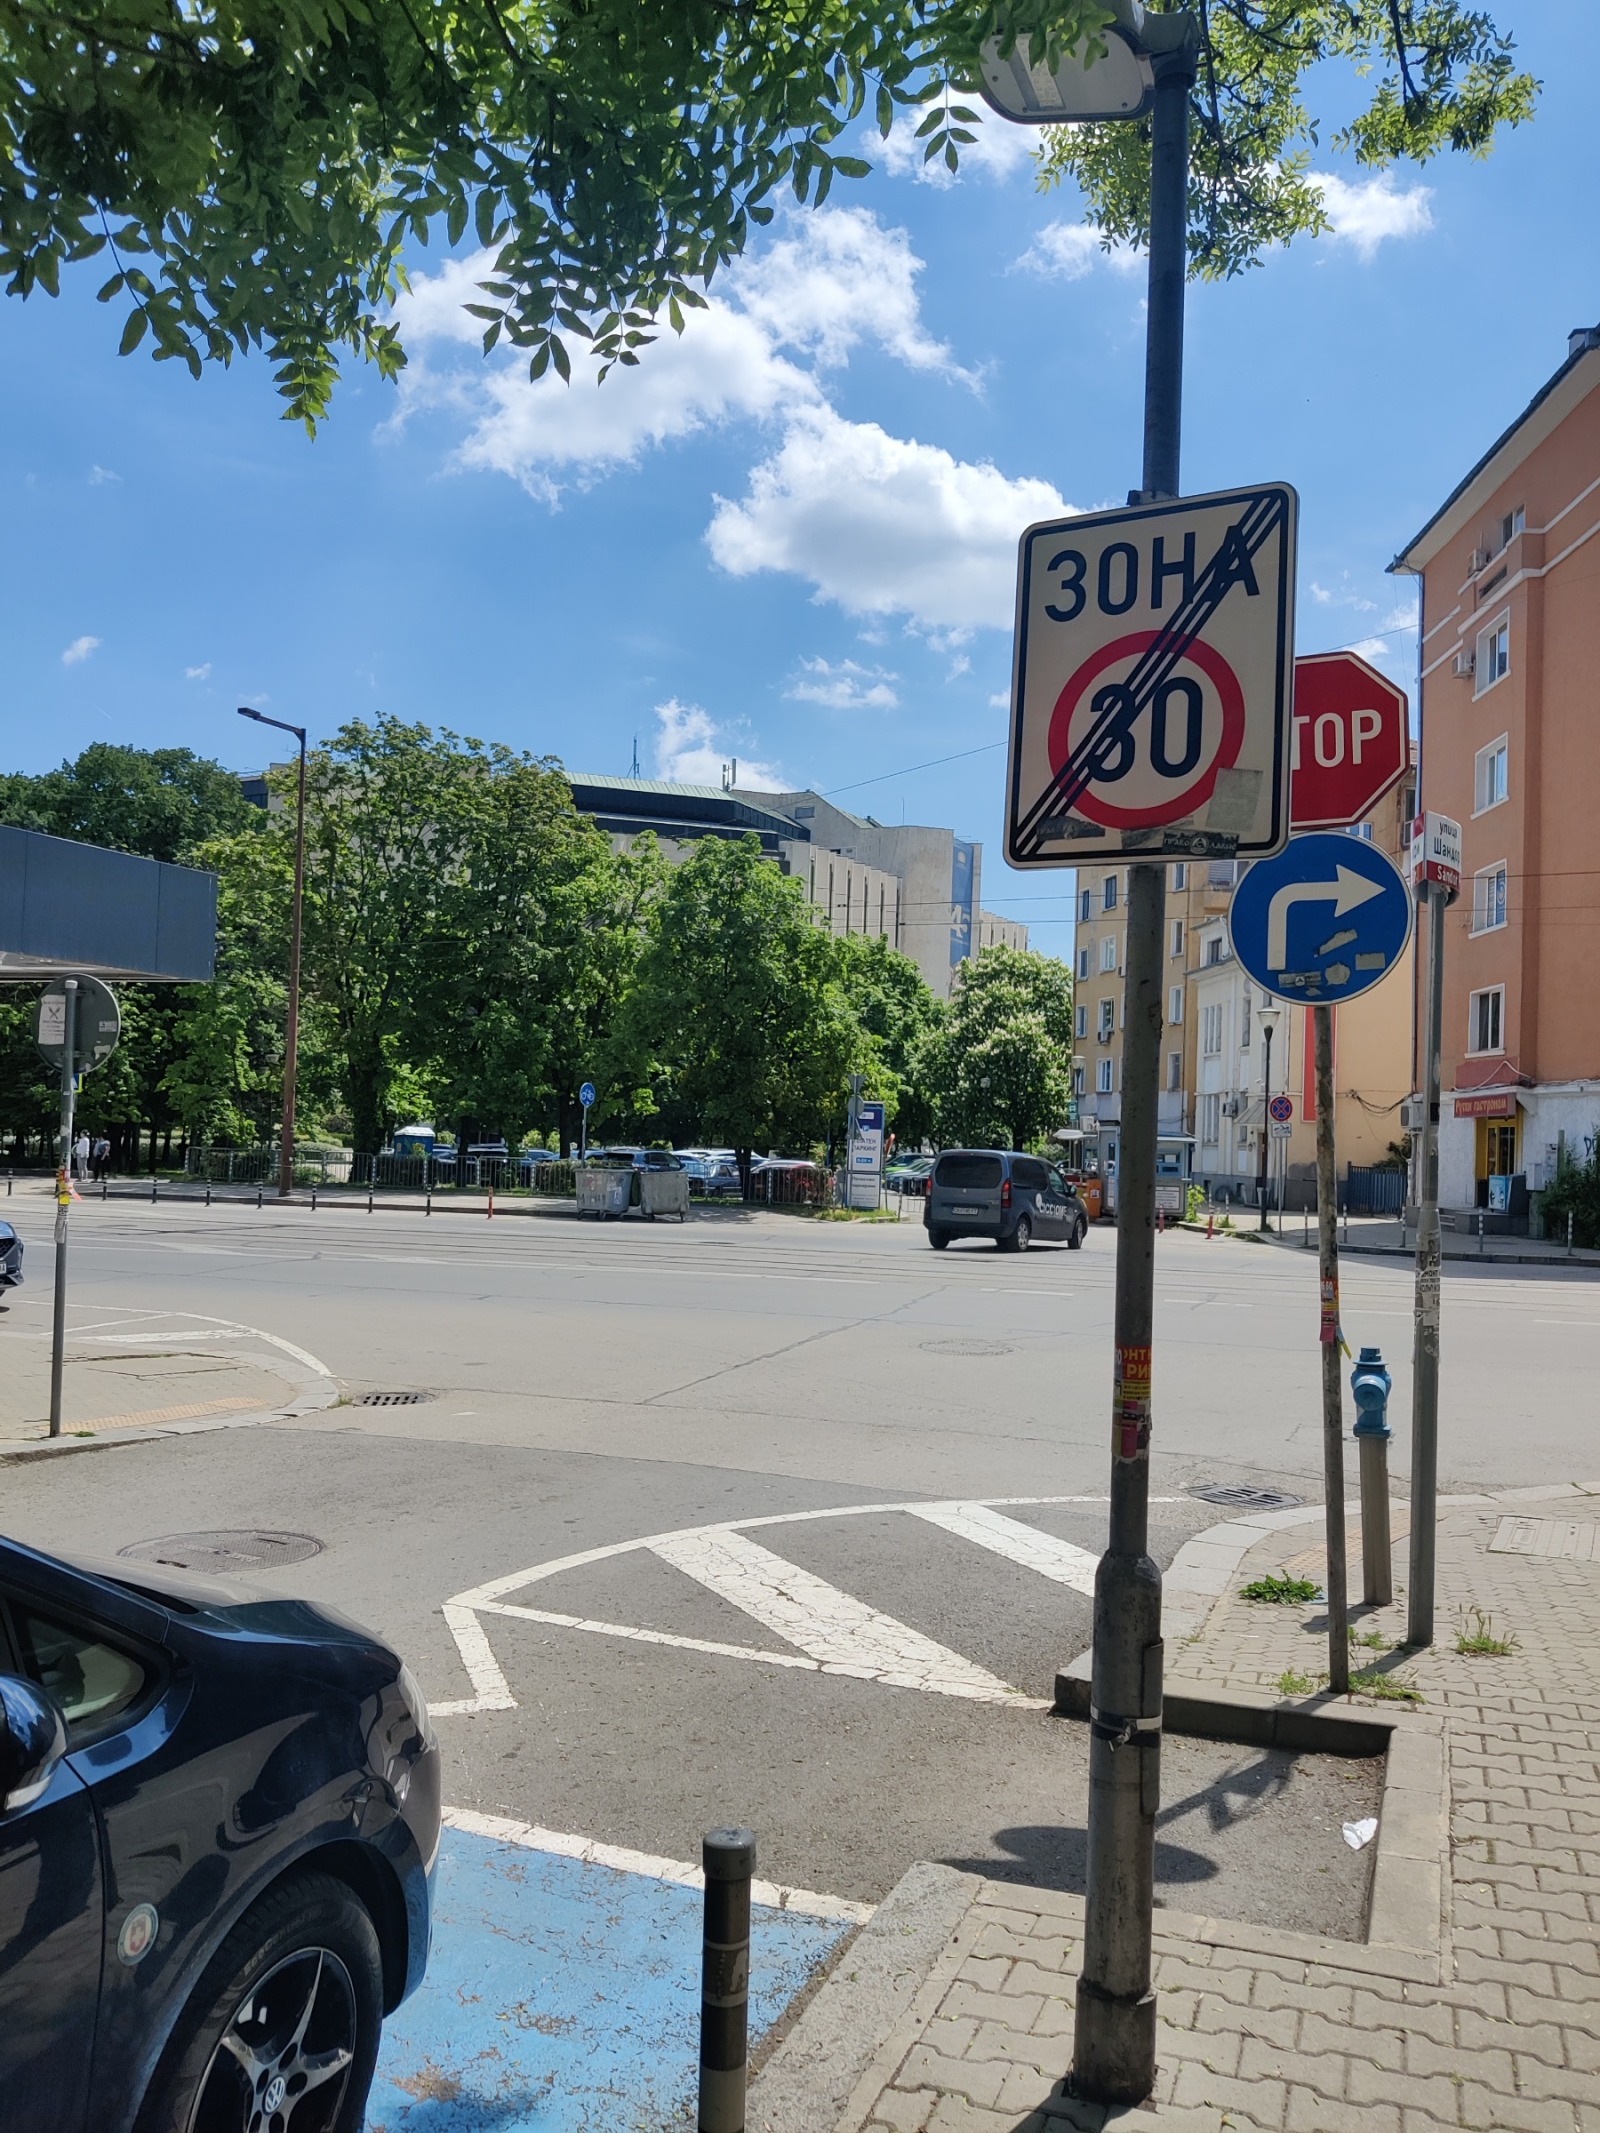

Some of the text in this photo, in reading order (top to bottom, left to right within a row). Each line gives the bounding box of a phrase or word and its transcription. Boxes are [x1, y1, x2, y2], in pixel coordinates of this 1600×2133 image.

[1045, 526, 1260, 622] ЗОНА
[1090, 677, 1203, 783] 30
[1292, 709, 1382, 768] TOP
